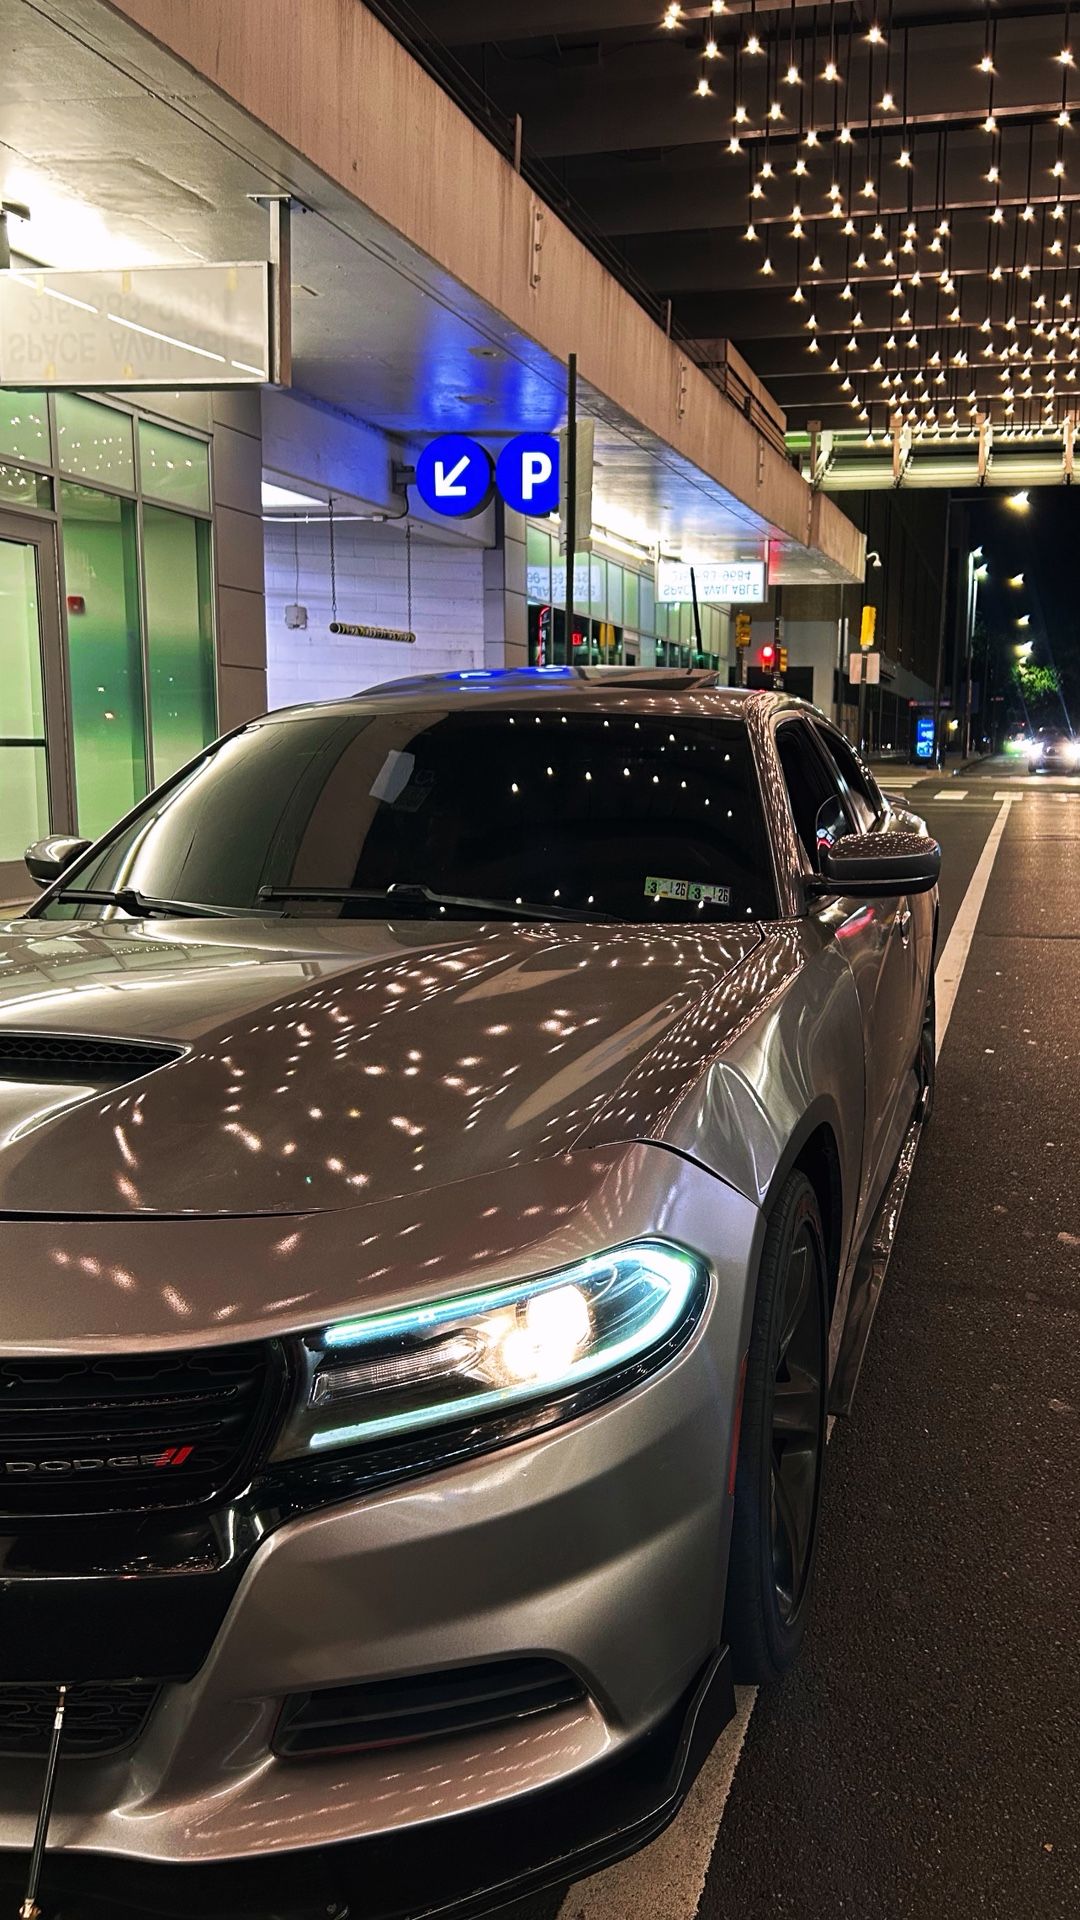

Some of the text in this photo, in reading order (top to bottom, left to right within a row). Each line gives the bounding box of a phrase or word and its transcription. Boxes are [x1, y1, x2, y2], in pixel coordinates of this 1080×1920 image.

[522, 452, 552, 500] P
[675, 882, 686, 896] 26
[718, 889, 728, 902] 26
[5, 1453, 171, 1473] DODGE
